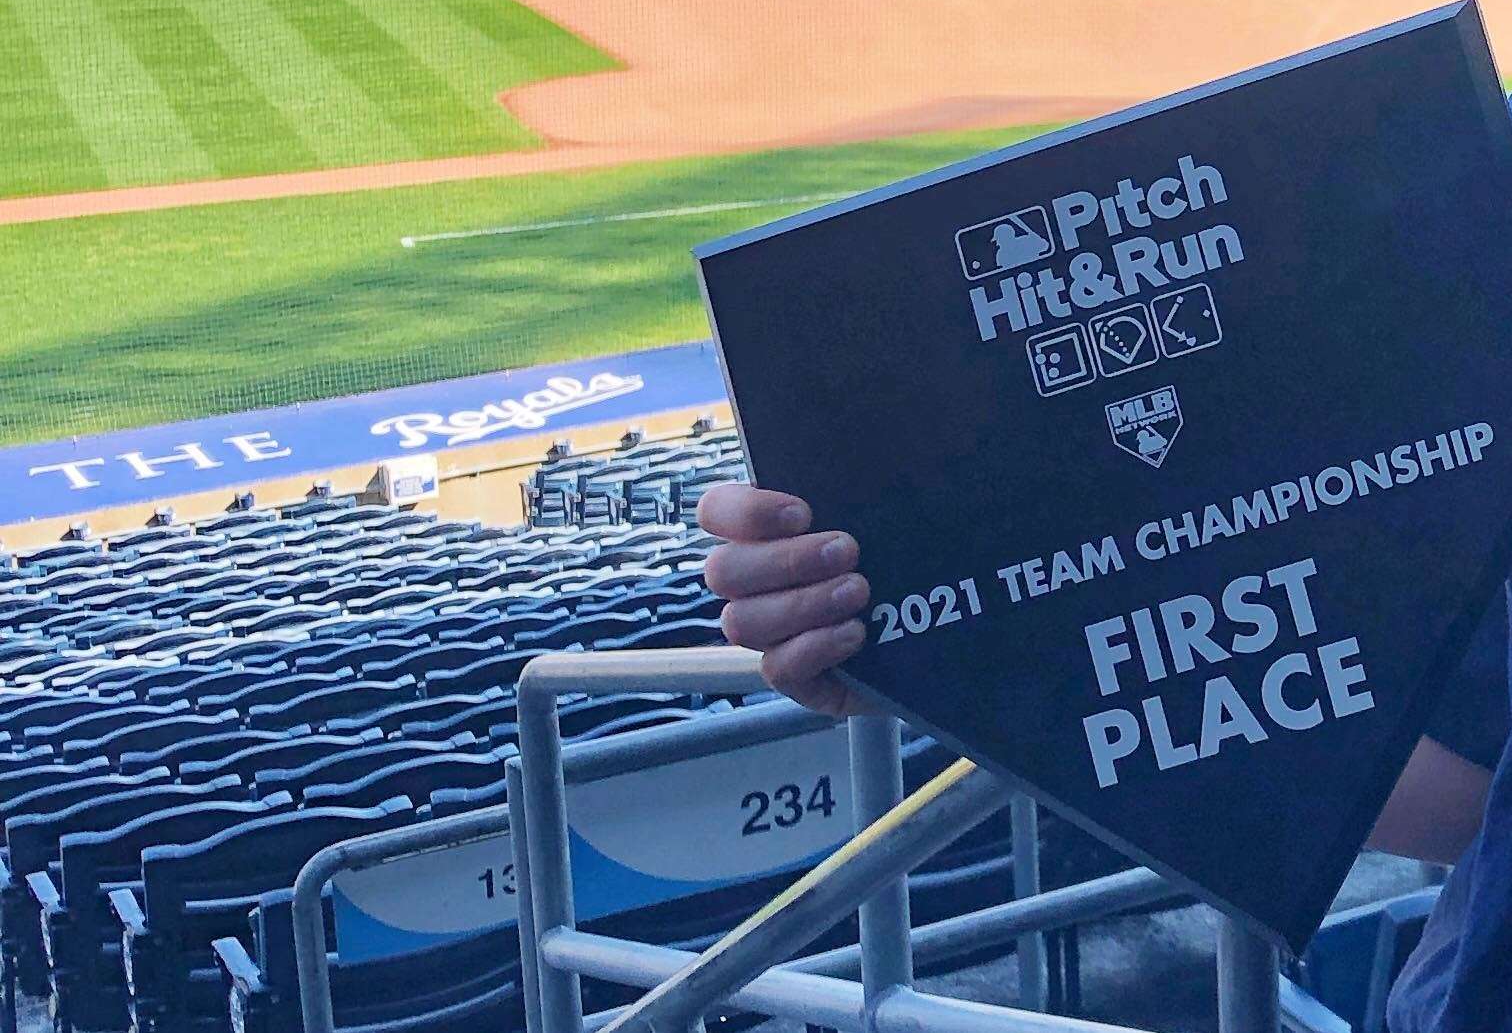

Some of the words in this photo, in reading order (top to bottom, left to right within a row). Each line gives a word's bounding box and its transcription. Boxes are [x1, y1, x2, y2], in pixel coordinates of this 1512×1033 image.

[1052, 155, 1229, 251] Pitch
[29, 431, 292, 490] THE
[371, 372, 644, 449] Royals
[1109, 390, 1175, 427] MLB
[1115, 410, 1178, 435] NETWORK
[872, 578, 982, 644] 2021
[997, 536, 1125, 604] TEAM
[1136, 422, 1494, 561] CHAMPIONSHIP
[1084, 558, 1318, 697] FIRST
[1082, 637, 1375, 790] PLACE
[740, 774, 837, 836] 234
